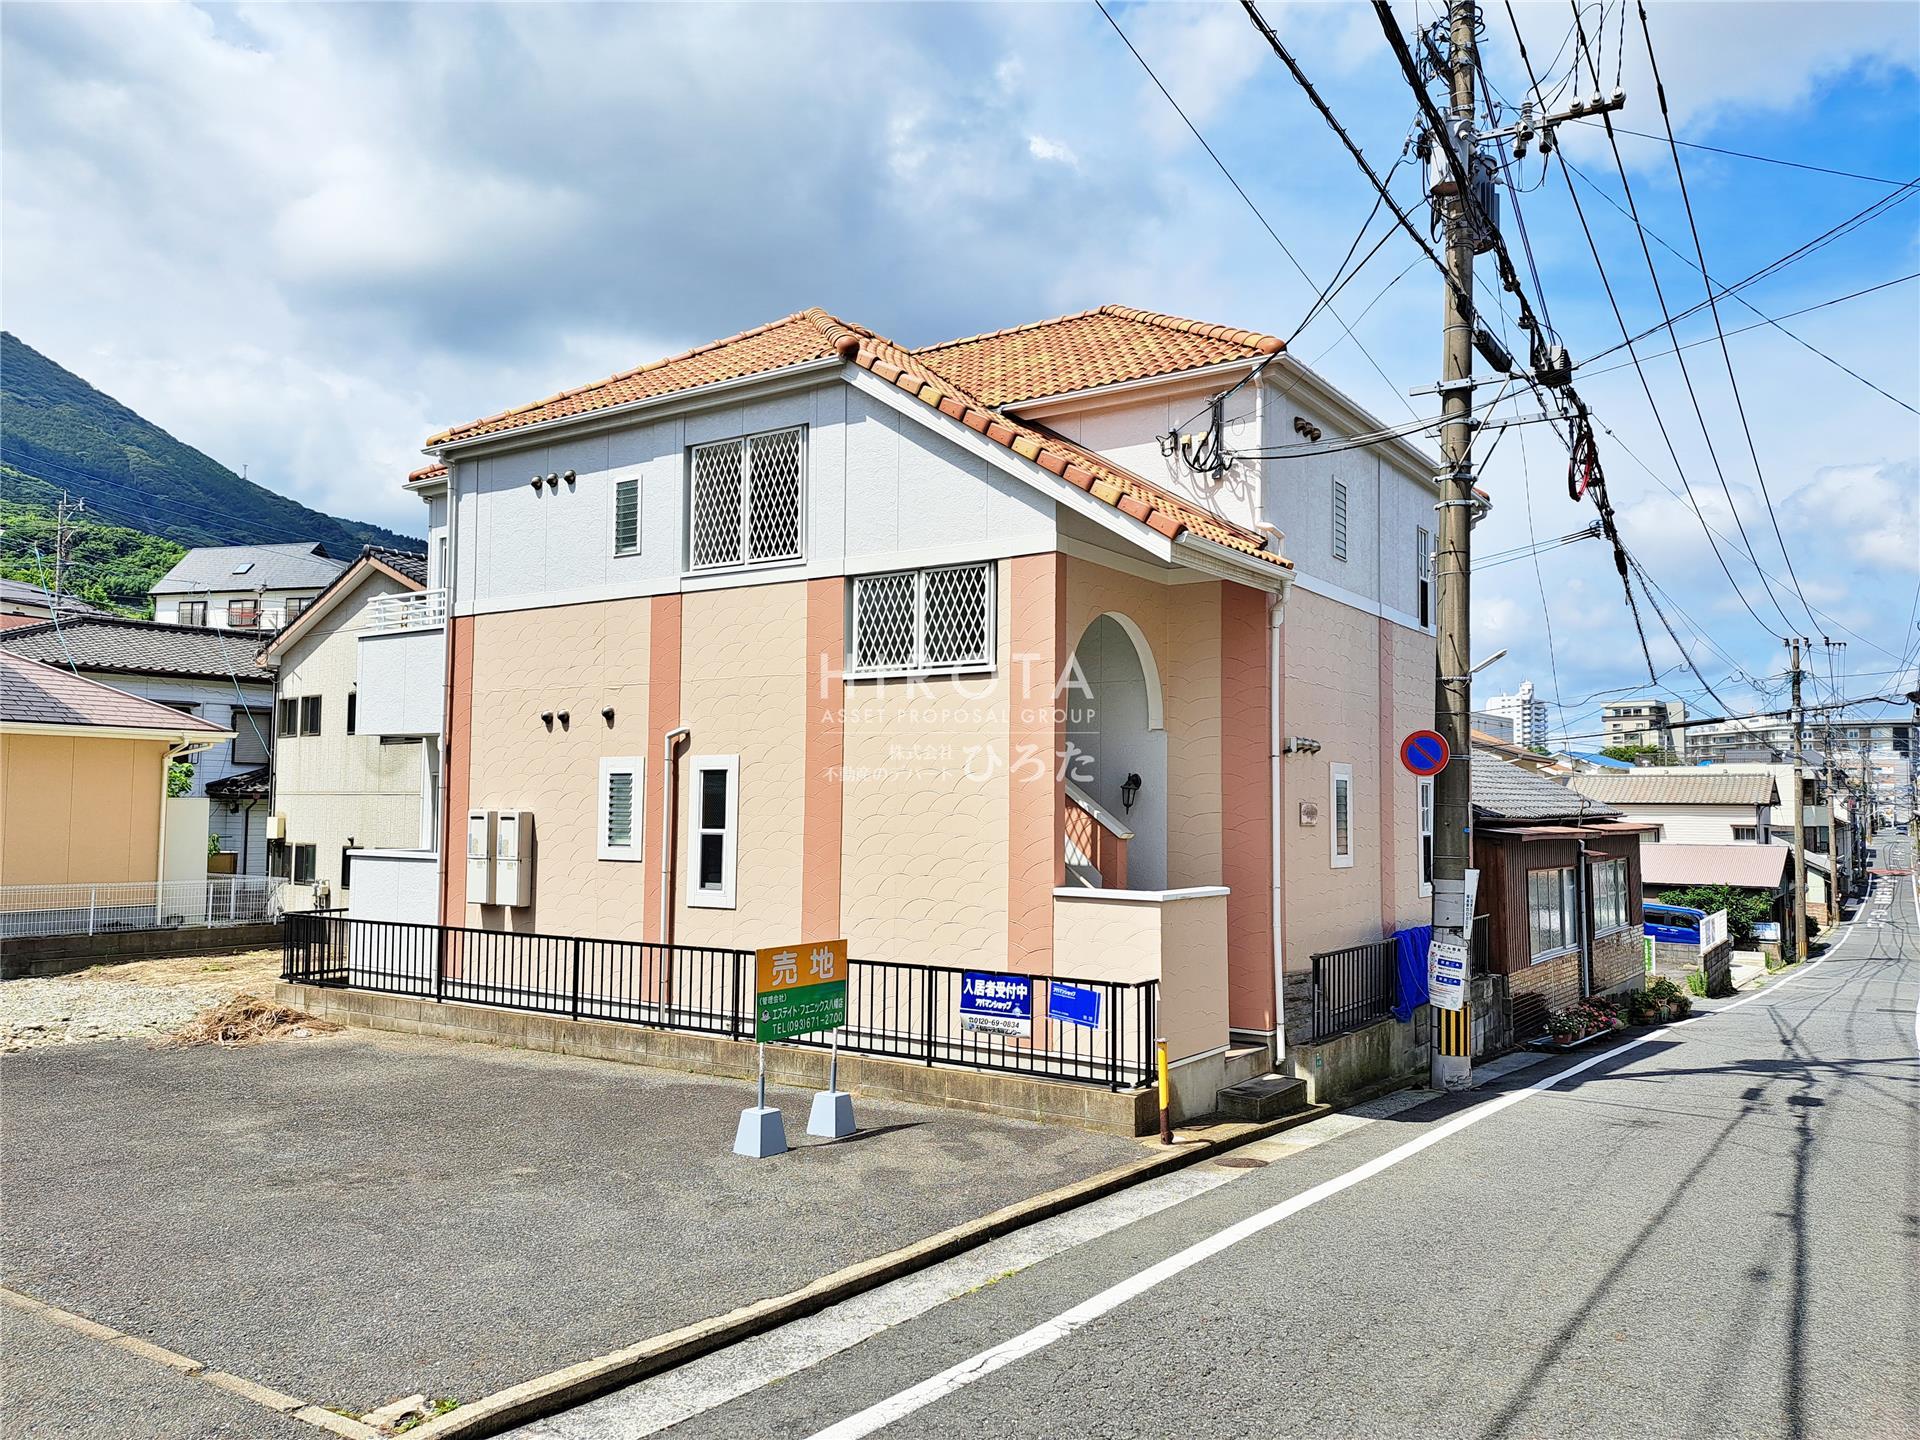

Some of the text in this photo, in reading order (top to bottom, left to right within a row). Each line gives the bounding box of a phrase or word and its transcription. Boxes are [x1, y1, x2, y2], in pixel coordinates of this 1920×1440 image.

[963, 978, 1028, 1000] 入居者受付中
[975, 998, 1013, 1011] アパマンショップ
[772, 1011, 843, 1035] TEL(093)671-2700
